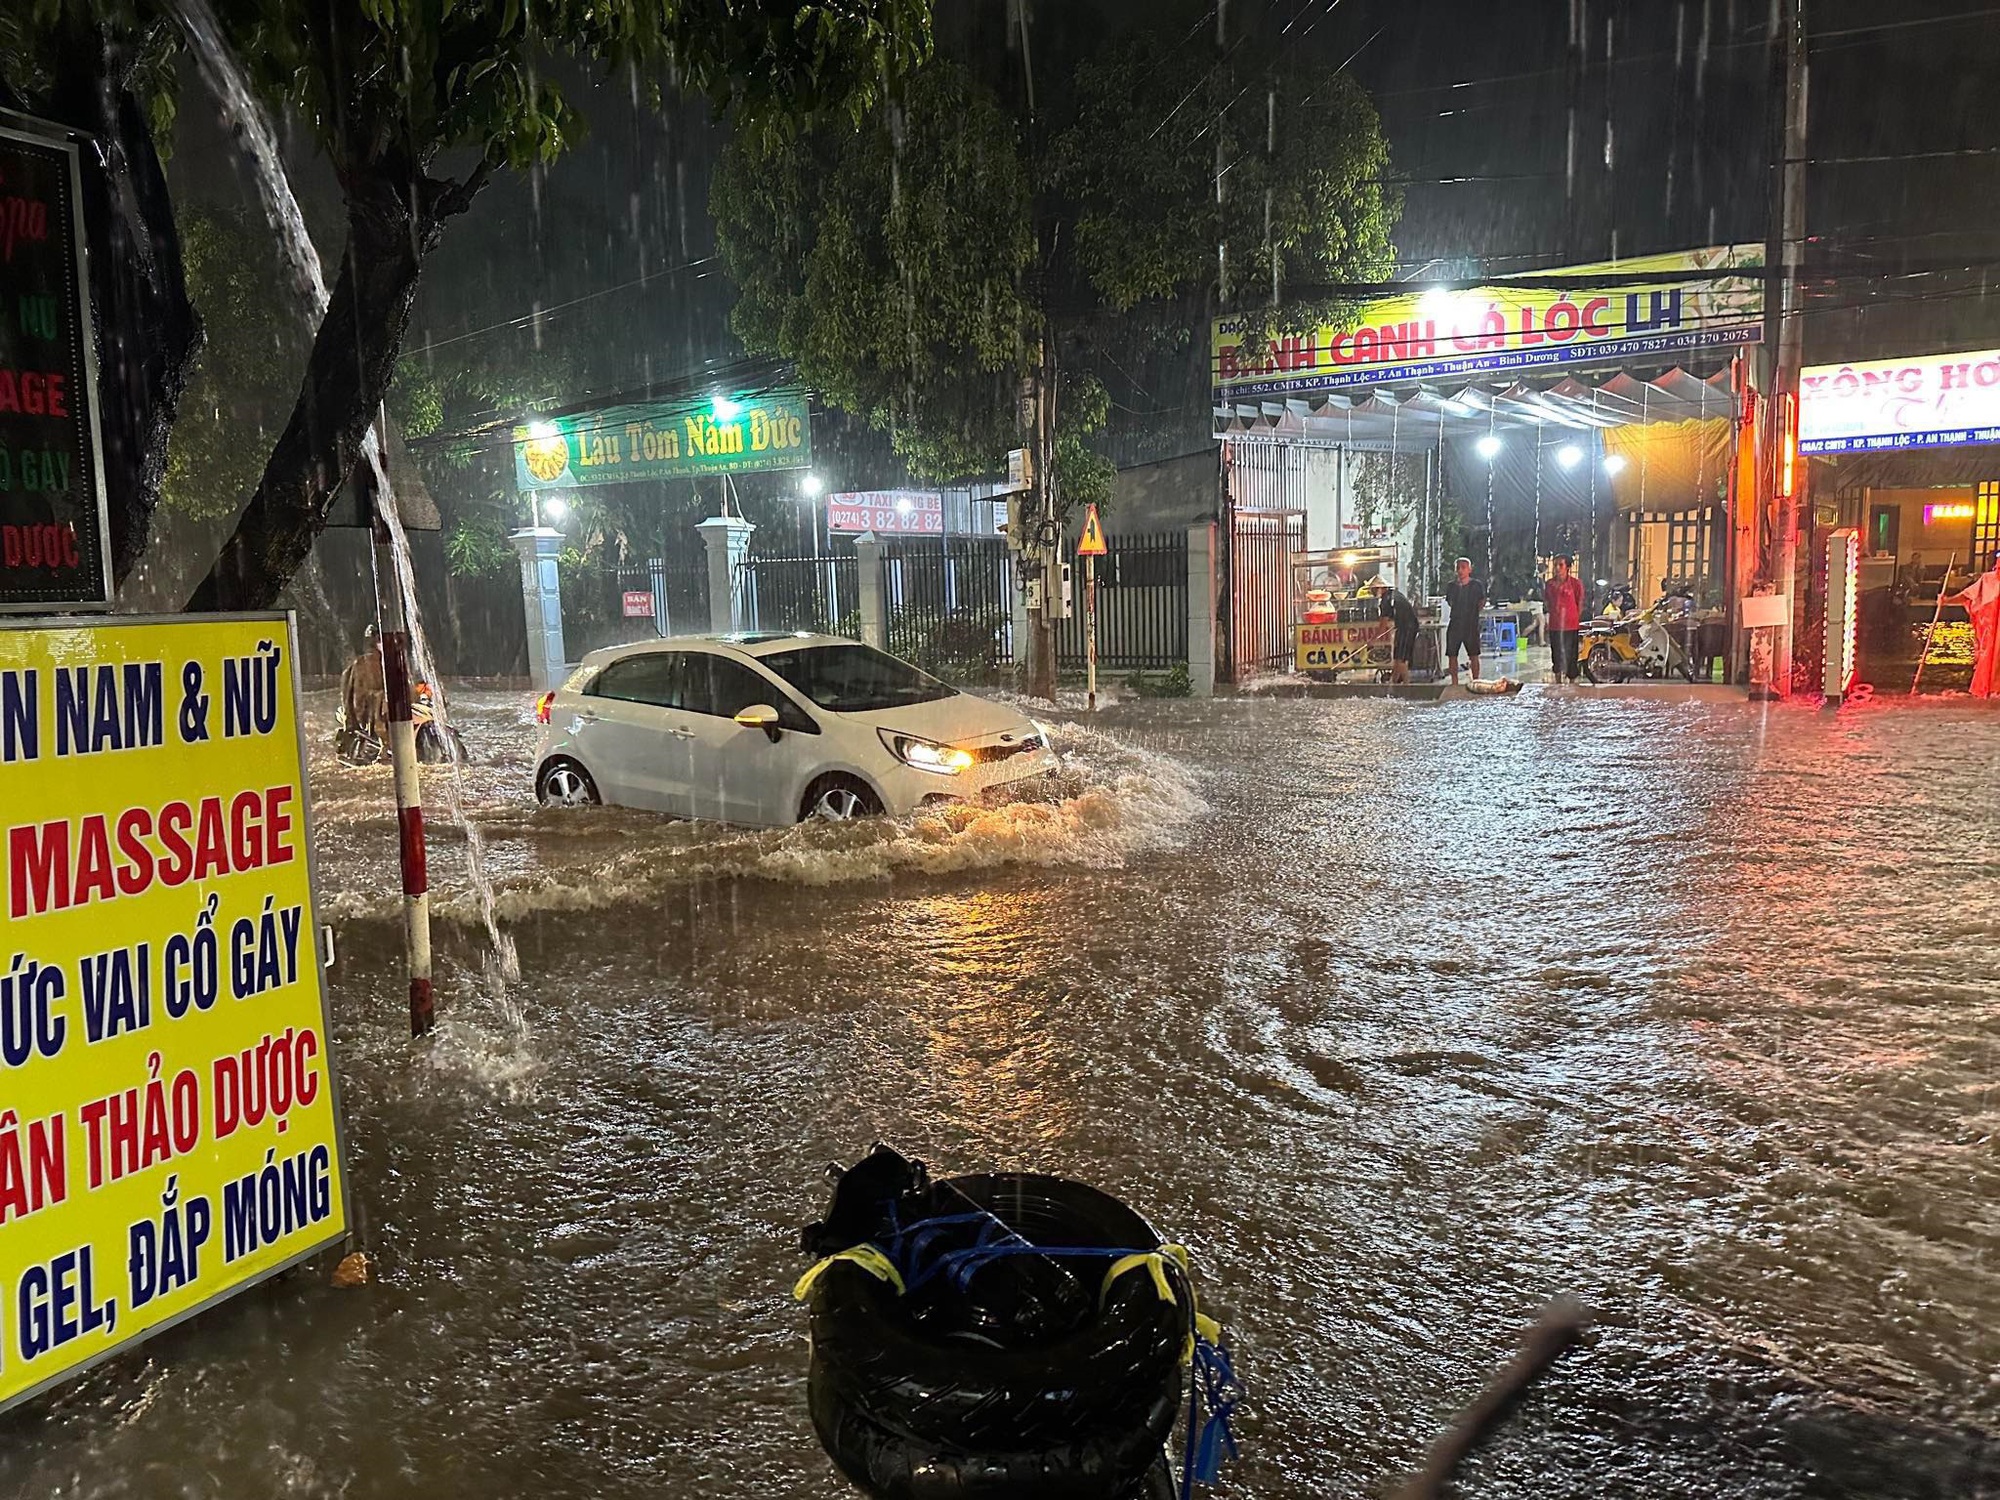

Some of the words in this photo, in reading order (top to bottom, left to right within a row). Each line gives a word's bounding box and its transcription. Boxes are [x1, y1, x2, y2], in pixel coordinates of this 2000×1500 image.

[1331, 319, 1435, 365] CANH
[1522, 294, 1609, 344] LÓC
[1626, 288, 1681, 332] LH
[1600, 343, 1617, 354] 039
[1621, 342, 1639, 352] 470
[1642, 338, 1666, 350] 7827
[1677, 336, 1696, 346] 034
[1701, 333, 1719, 344] 270
[1723, 330, 1749, 341] 2075
[1323, 373, 1351, 385] Thạnh
[1354, 372, 1370, 384] Lộc
[1378, 370, 1386, 380] P.
[1389, 369, 1402, 379] An
[1404, 365, 1434, 377] Thạnh
[1443, 360, 1474, 371] Thuận
[1475, 359, 1490, 369] An
[1525, 352, 1559, 363] Dương
[625, 421, 680, 462] Tôm
[685, 413, 744, 457] Năm
[750, 405, 801, 451] Đức
[1925, 433, 1938, 443] AN
[832, 510, 860, 525] (0274)
[861, 510, 870, 529] 3
[876, 510, 895, 529] 82
[901, 511, 919, 530] 82
[925, 513, 942, 530] 82
[868, 493, 893, 507] TAXI
[1306, 647, 1328, 664] CÁ
[56, 662, 163, 756] NAM
[179, 660, 210, 742] &
[224, 639, 281, 738] NỮ
[9, 785, 295, 919] MASSAGE
[80, 943, 150, 1044] VAI
[165, 893, 219, 1018] CỔ
[231, 895, 302, 1000] GÁY
[80, 1051, 200, 1190] THẢO
[213, 1027, 318, 1140] DƯỢC
[19, 1245, 117, 1361] GEL,
[129, 1174, 211, 1310] ĐẮP
[224, 1145, 331, 1264] MÓNG
